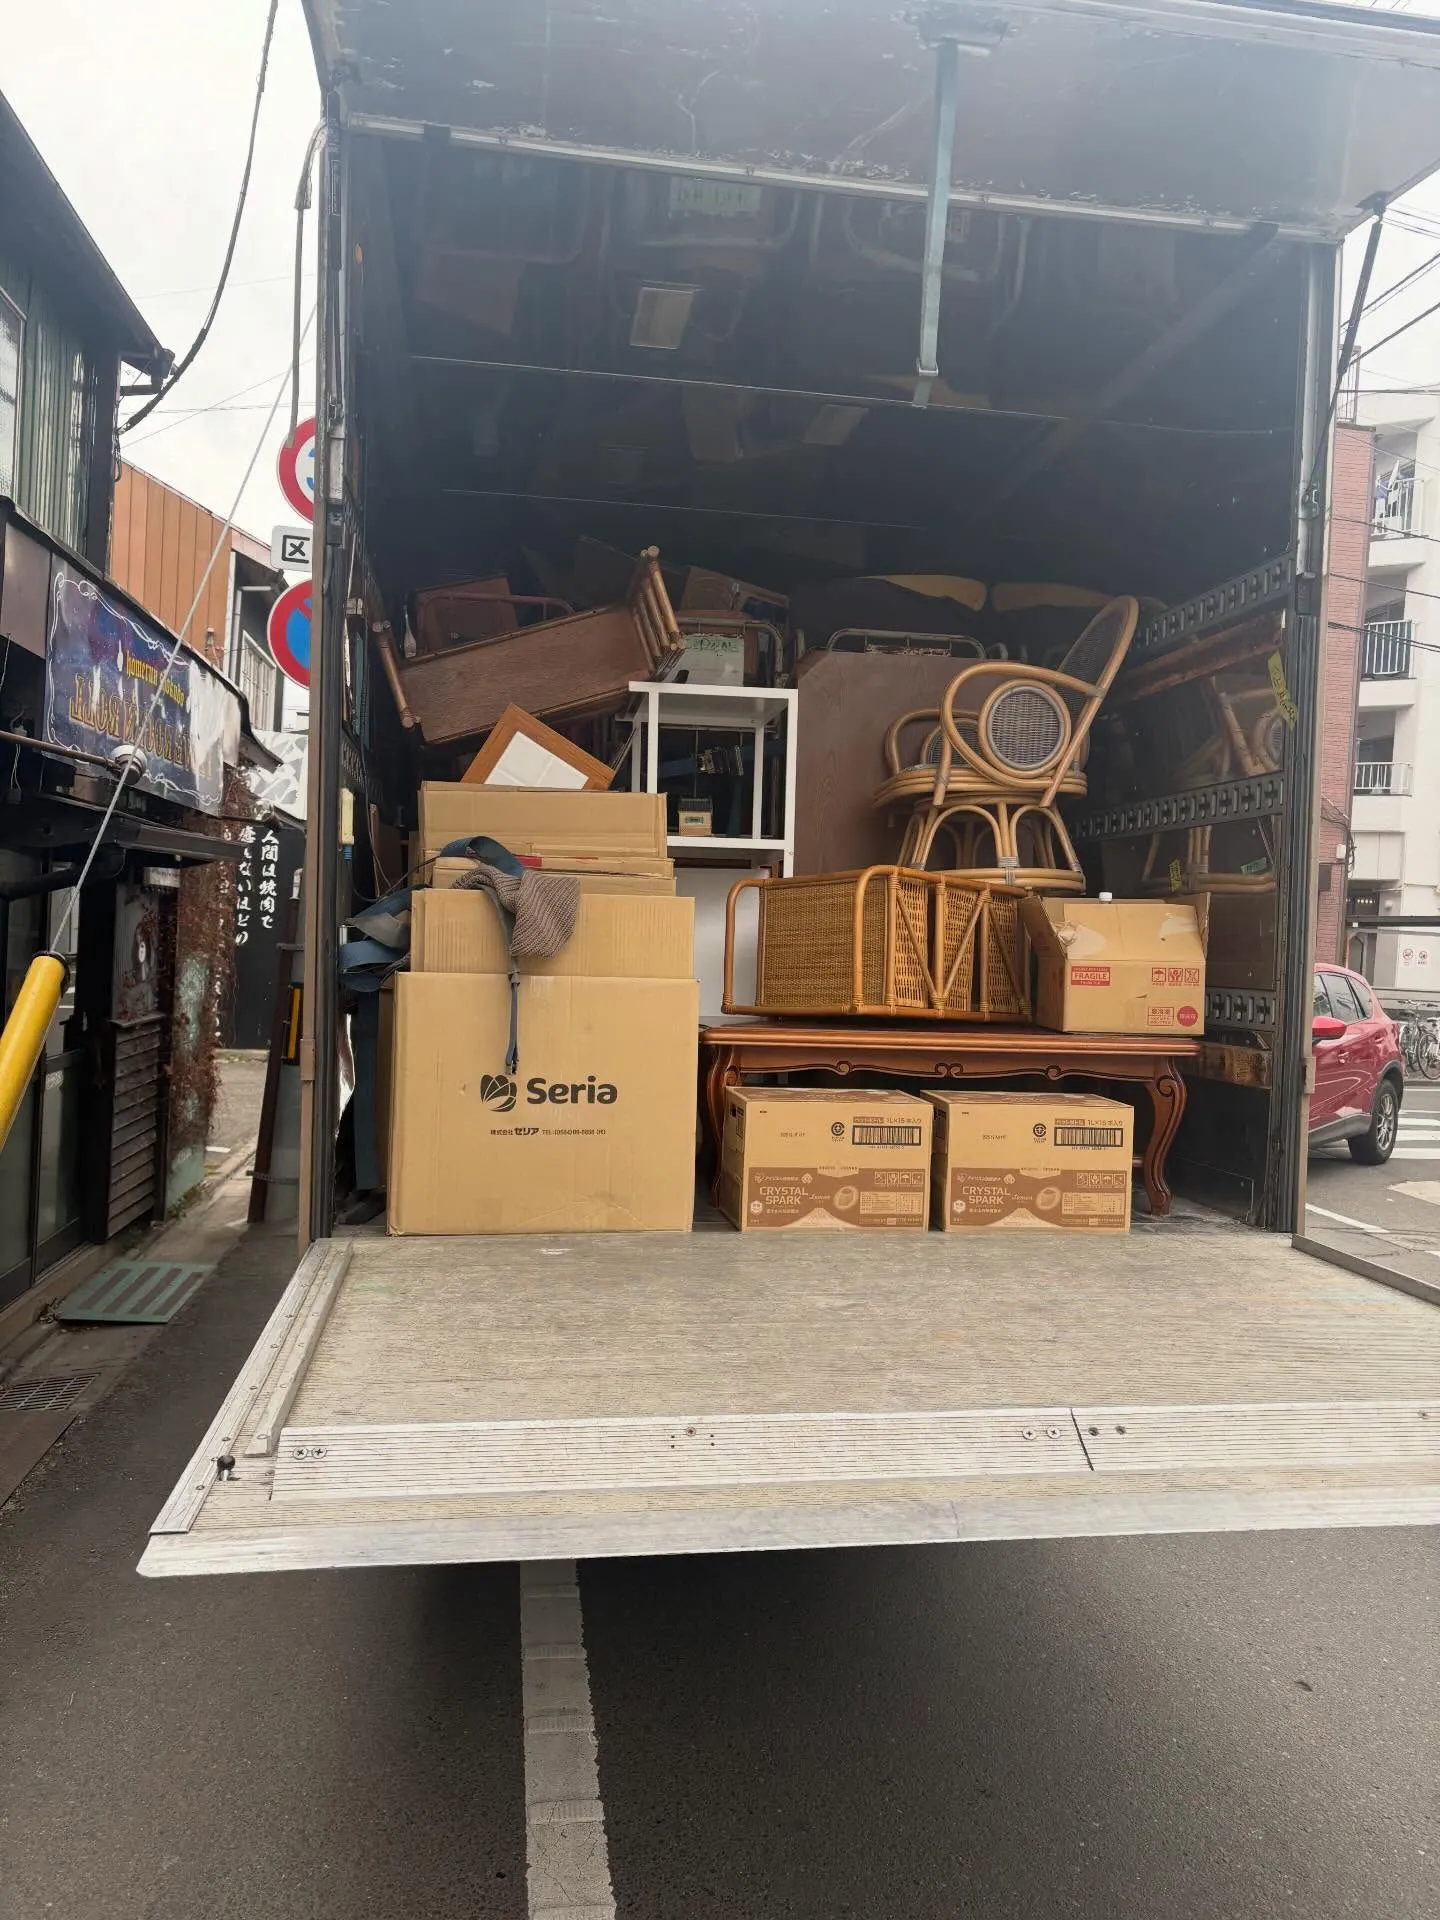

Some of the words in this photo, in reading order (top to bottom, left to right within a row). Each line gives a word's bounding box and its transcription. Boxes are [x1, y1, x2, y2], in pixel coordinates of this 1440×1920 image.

[259, 829, 279, 929] 人間は焼肉で
[1074, 972, 1107, 980] FRAGILE
[526, 1075, 617, 1105] Seria
[759, 1186, 809, 1196] CRYSTAL
[962, 1186, 1011, 1196] CRYSTAL
[765, 1195, 801, 1205] SPARK
[968, 1195, 1005, 1205] SPARK
